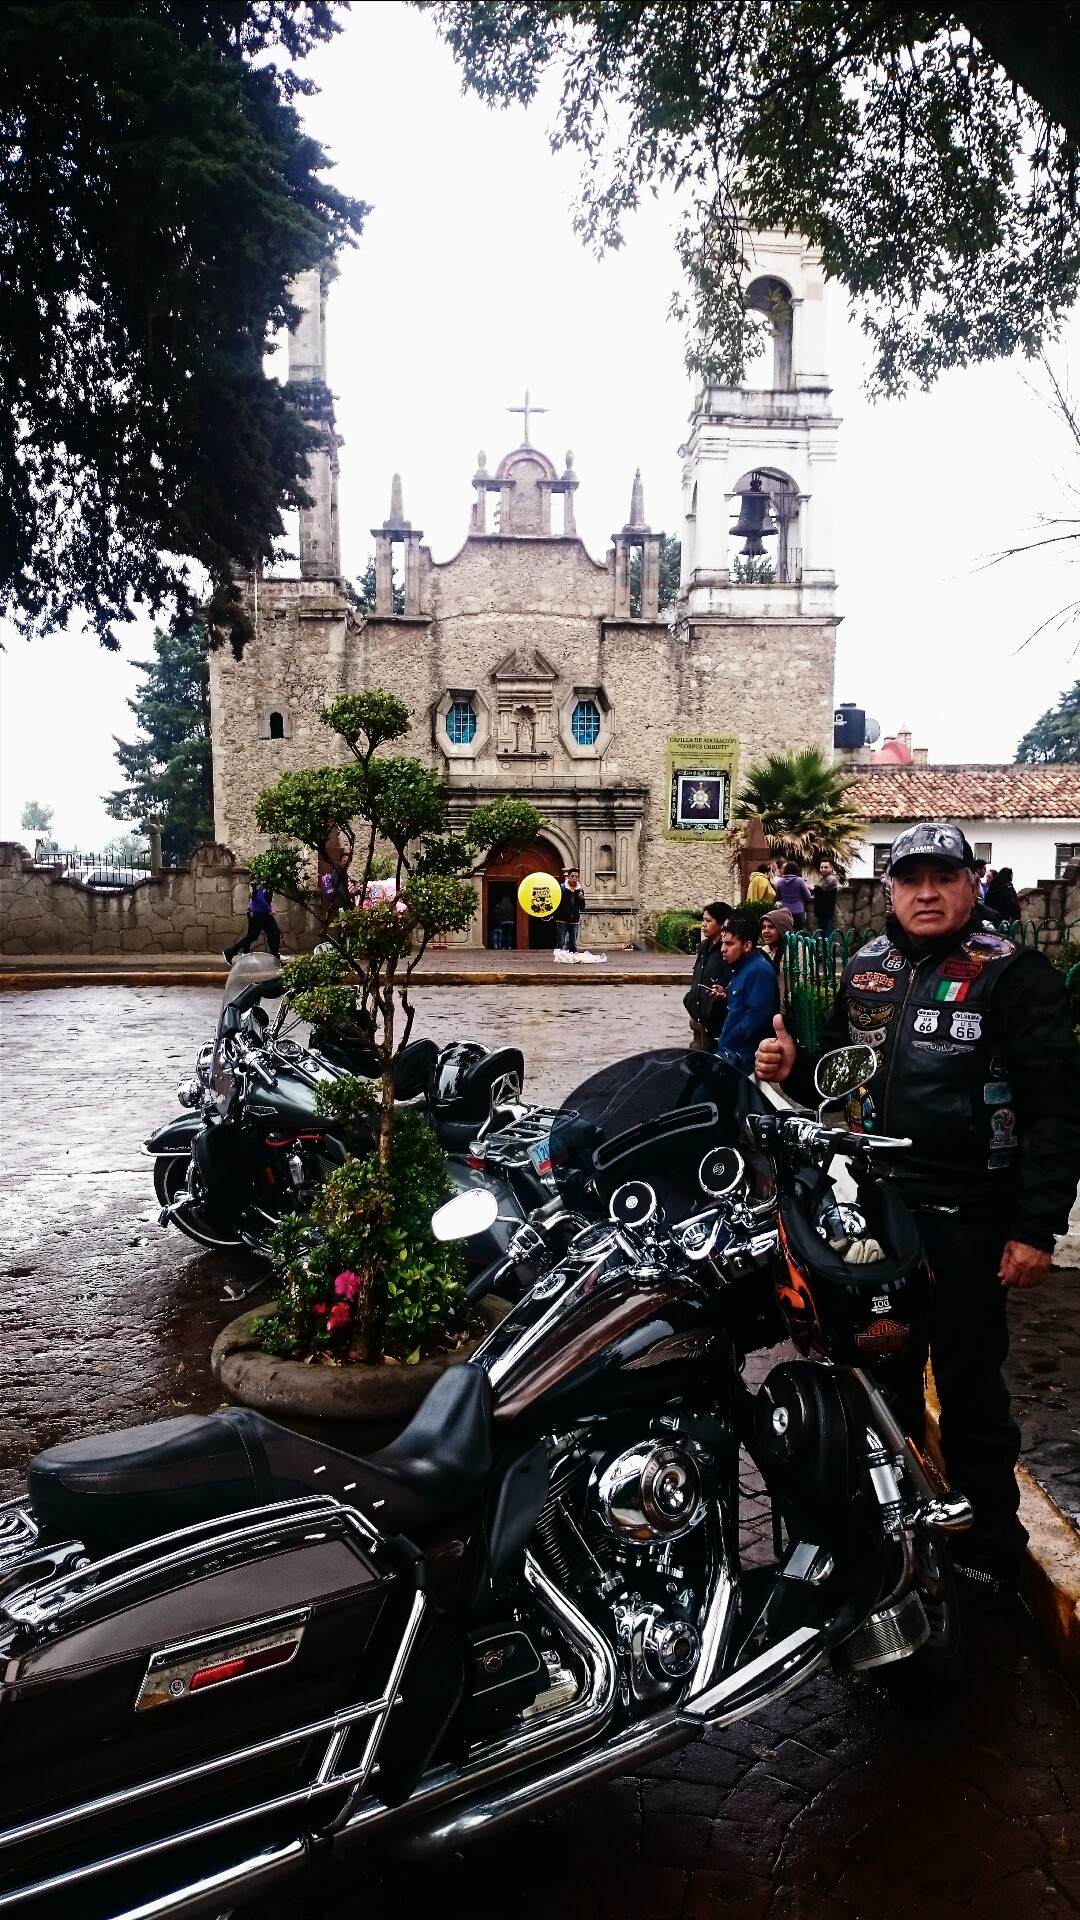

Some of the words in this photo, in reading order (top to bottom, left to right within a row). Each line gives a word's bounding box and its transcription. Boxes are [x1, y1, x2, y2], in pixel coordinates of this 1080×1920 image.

[887, 960, 901, 969] 66
[852, 973, 895, 987] STURGIS
[919, 1022, 932, 1032] 66
[956, 1027, 975, 1039] 66
[873, 1299, 890, 1309] DOT
